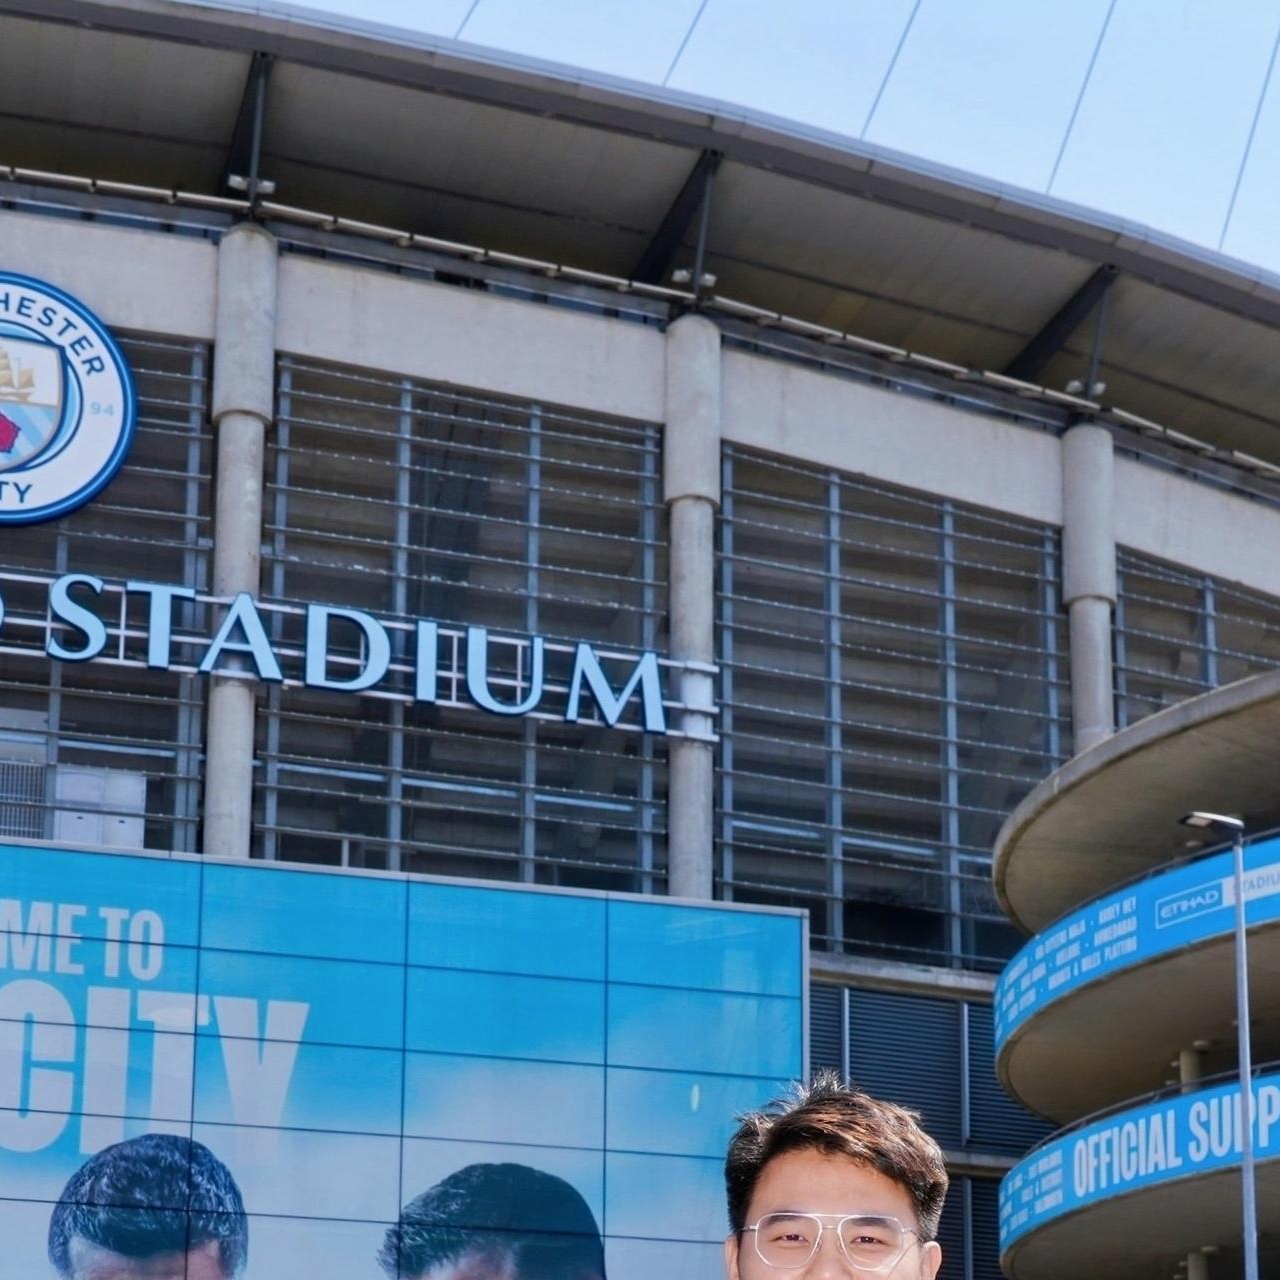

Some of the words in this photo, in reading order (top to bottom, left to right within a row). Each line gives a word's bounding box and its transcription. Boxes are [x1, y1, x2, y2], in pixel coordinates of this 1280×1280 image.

[90, 402, 114, 416] 94
[46, 572, 667, 734] STADIUM
[1160, 890, 1219, 919] ETIHAD
[99, 906, 165, 981] TO
[1074, 1110, 1182, 1198] OFFICIAL
